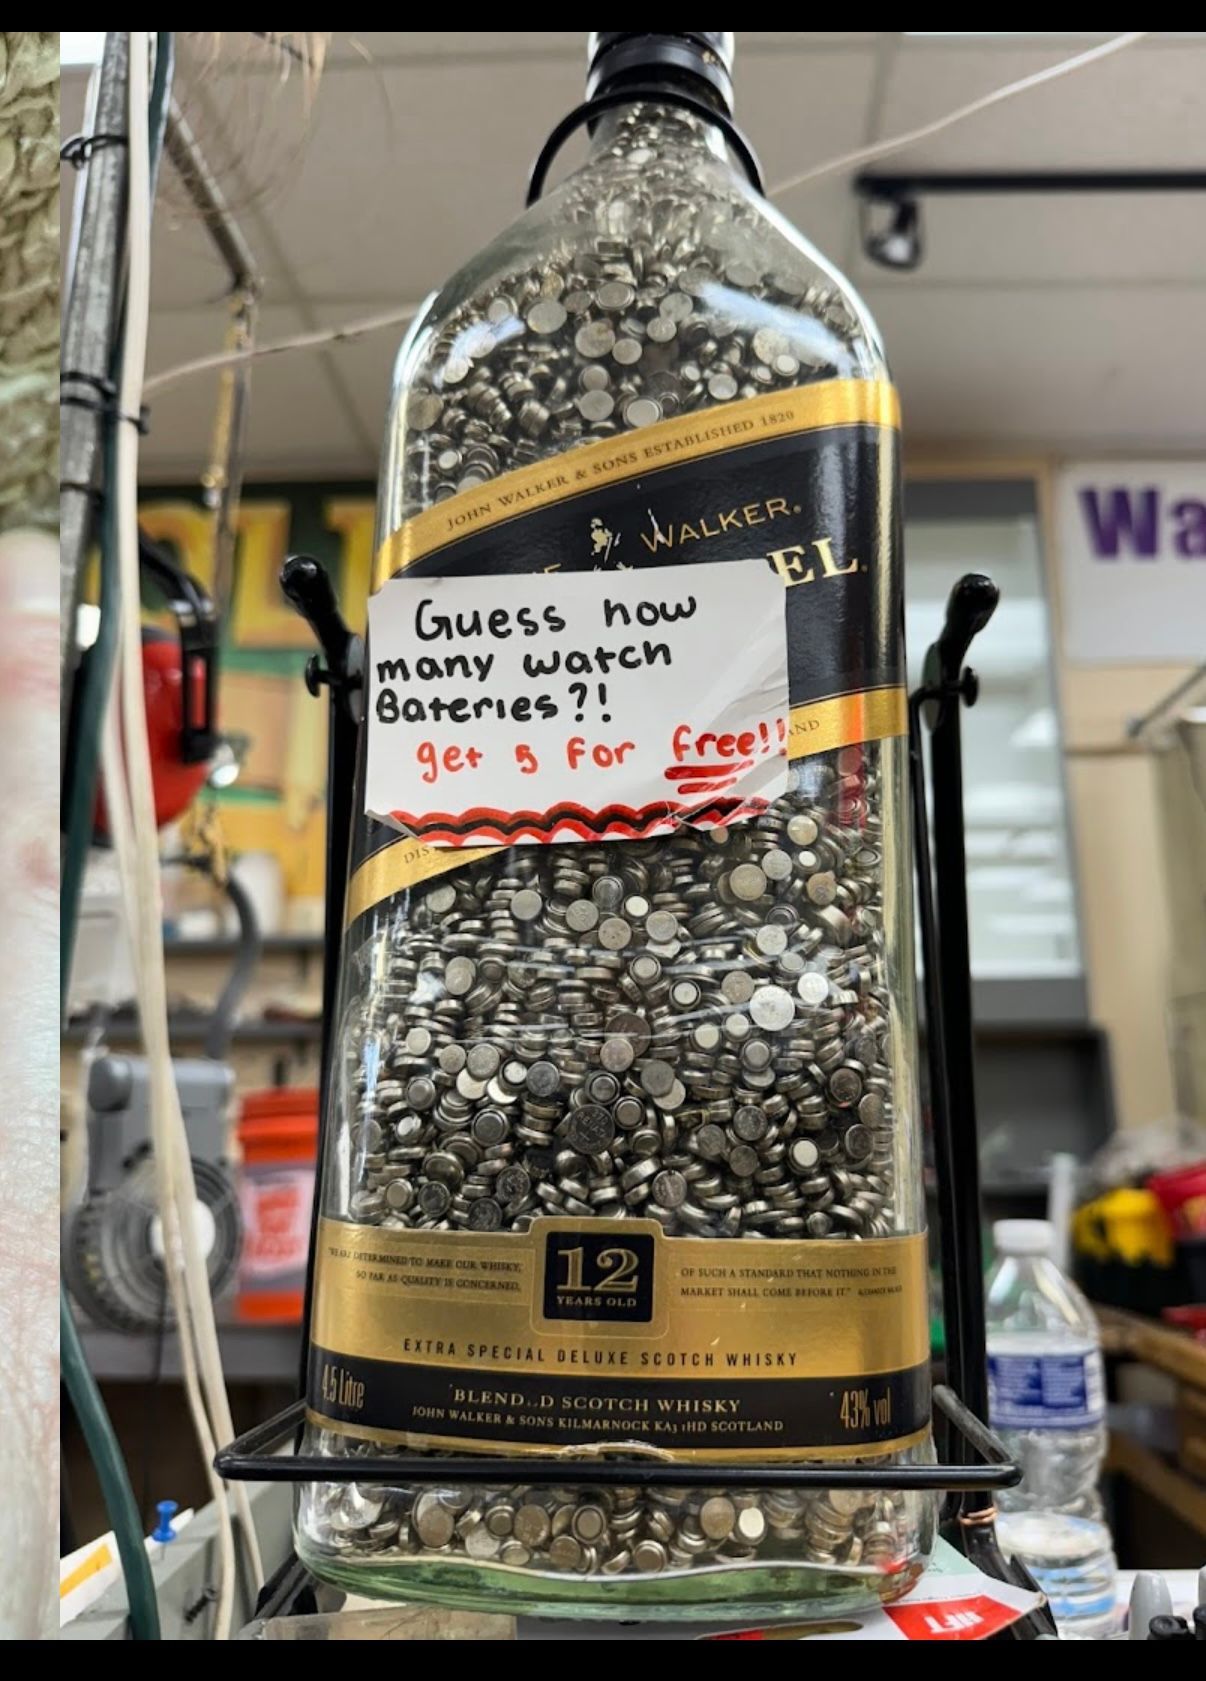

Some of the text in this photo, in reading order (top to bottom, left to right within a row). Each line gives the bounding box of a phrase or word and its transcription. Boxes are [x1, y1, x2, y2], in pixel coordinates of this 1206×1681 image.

[448, 410, 795, 531] JOHN WALKER & SONS ESTABLISHED 1820
[415, 595, 697, 641] Guess how
[376, 640, 672, 683] many watch
[415, 738, 484, 784] get
[514, 742, 539, 774] 5
[409, 1256, 422, 1267] TO
[426, 1258, 452, 1269] MAKE
[456, 1259, 477, 1270] OUR
[556, 1246, 639, 1293] 12
[681, 1267, 695, 1277] OF
[699, 1267, 727, 1278] SUCH
[729, 1268, 736, 1278] A
[739, 1268, 794, 1279] STANDARD
[796, 1268, 823, 1279] THAT
[826, 1267, 869, 1278] NOTHING
[556, 1295, 637, 1308] YEARS OLD
[680, 1287, 724, 1297] MARKET
[727, 1287, 759, 1298] SHALL
[763, 1287, 792, 1298] COME
[795, 1287, 833, 1297] BEFORE
[404, 1337, 797, 1367] EXTRA SPECIAL DELUXE SCOTCH WHISKY
[338, 1367, 365, 1409] Litre
[454, 1388, 741, 1413] BLENDD SCOTCH WHISKY
[412, 1405, 445, 1419] JOHN
[448, 1408, 502, 1424] WALKER
[505, 1415, 516, 1426] &
[519, 1415, 553, 1427] SONS
[558, 1417, 650, 1431] KILMARNOCK
[655, 1420, 678, 1434] KA3
[711, 1420, 784, 1432] SCOTLAND
[840, 1386, 891, 1429] 43% vol
